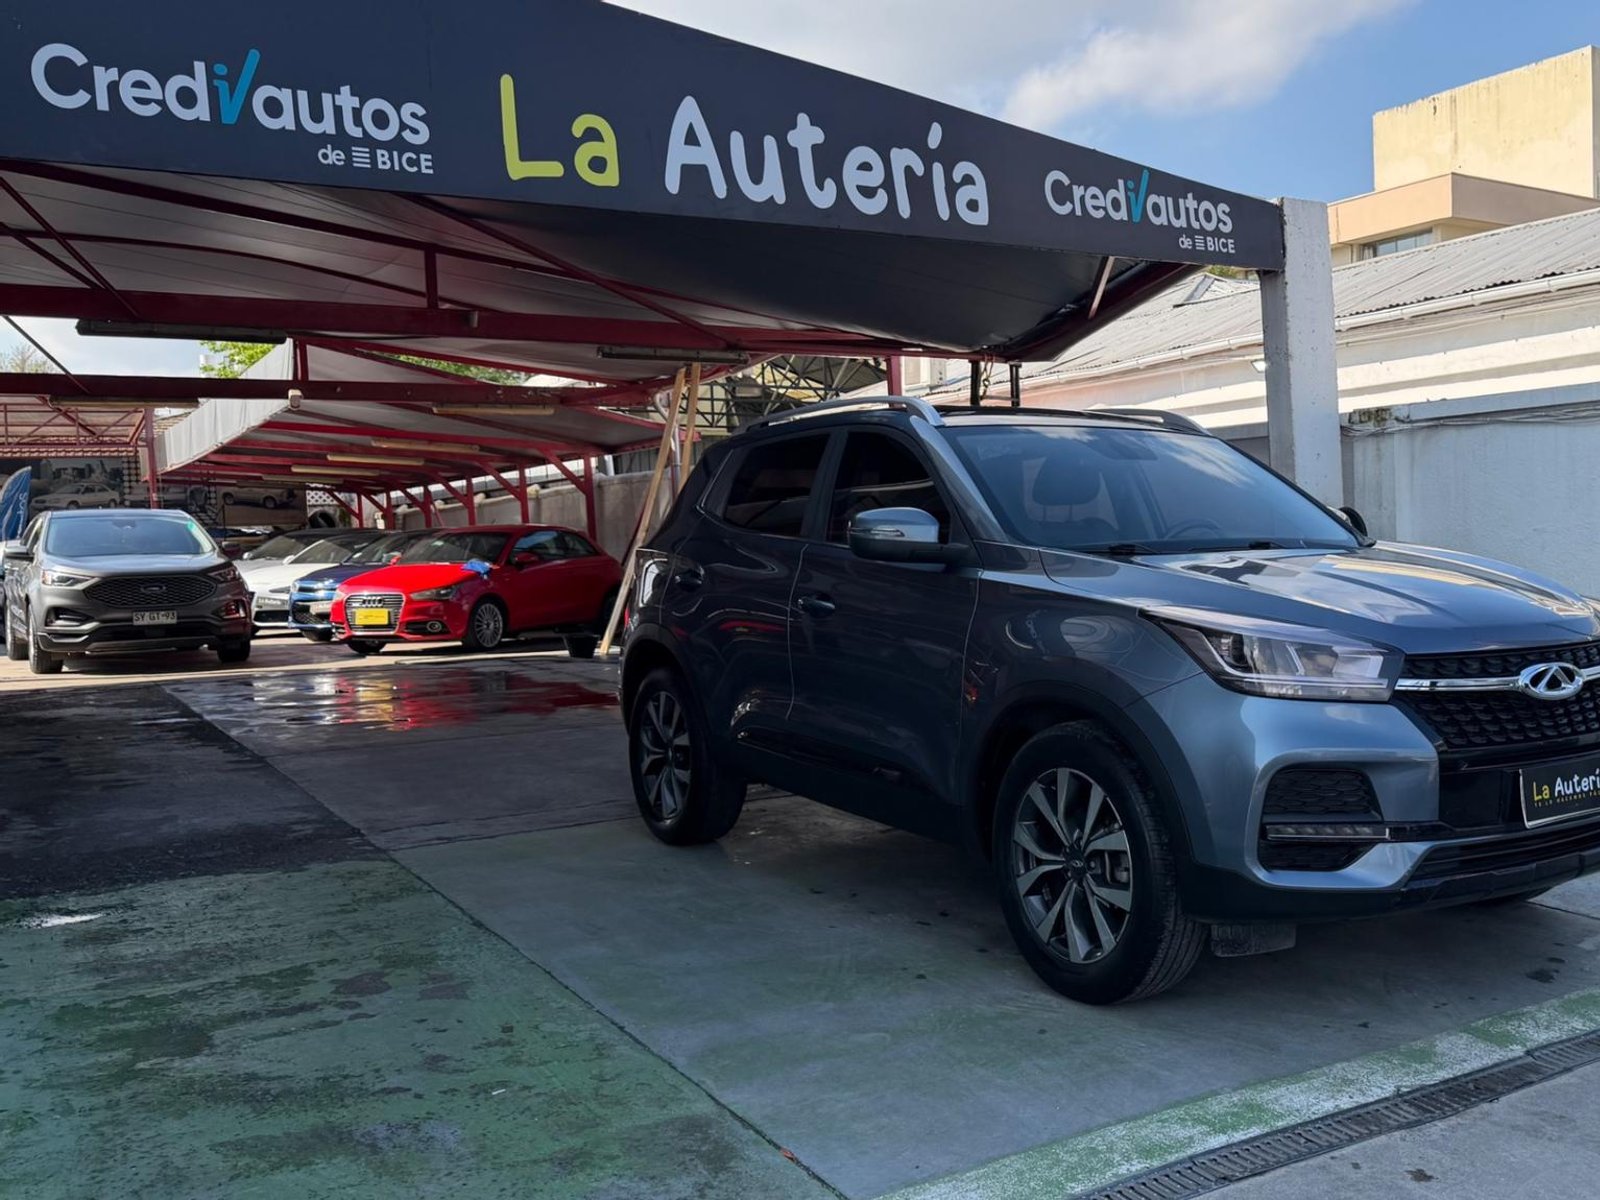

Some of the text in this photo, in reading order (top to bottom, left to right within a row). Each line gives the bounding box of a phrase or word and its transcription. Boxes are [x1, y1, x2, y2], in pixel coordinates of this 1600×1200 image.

[30, 42, 431, 145] Crediautos
[317, 144, 434, 175] de BICE
[499, 74, 990, 227] La Autería
[1044, 169, 1233, 234] Crediautos
[1178, 234, 1236, 253] de BICE
[1533, 781, 1550, 801] La
[1554, 768, 1600, 797] Auterí
